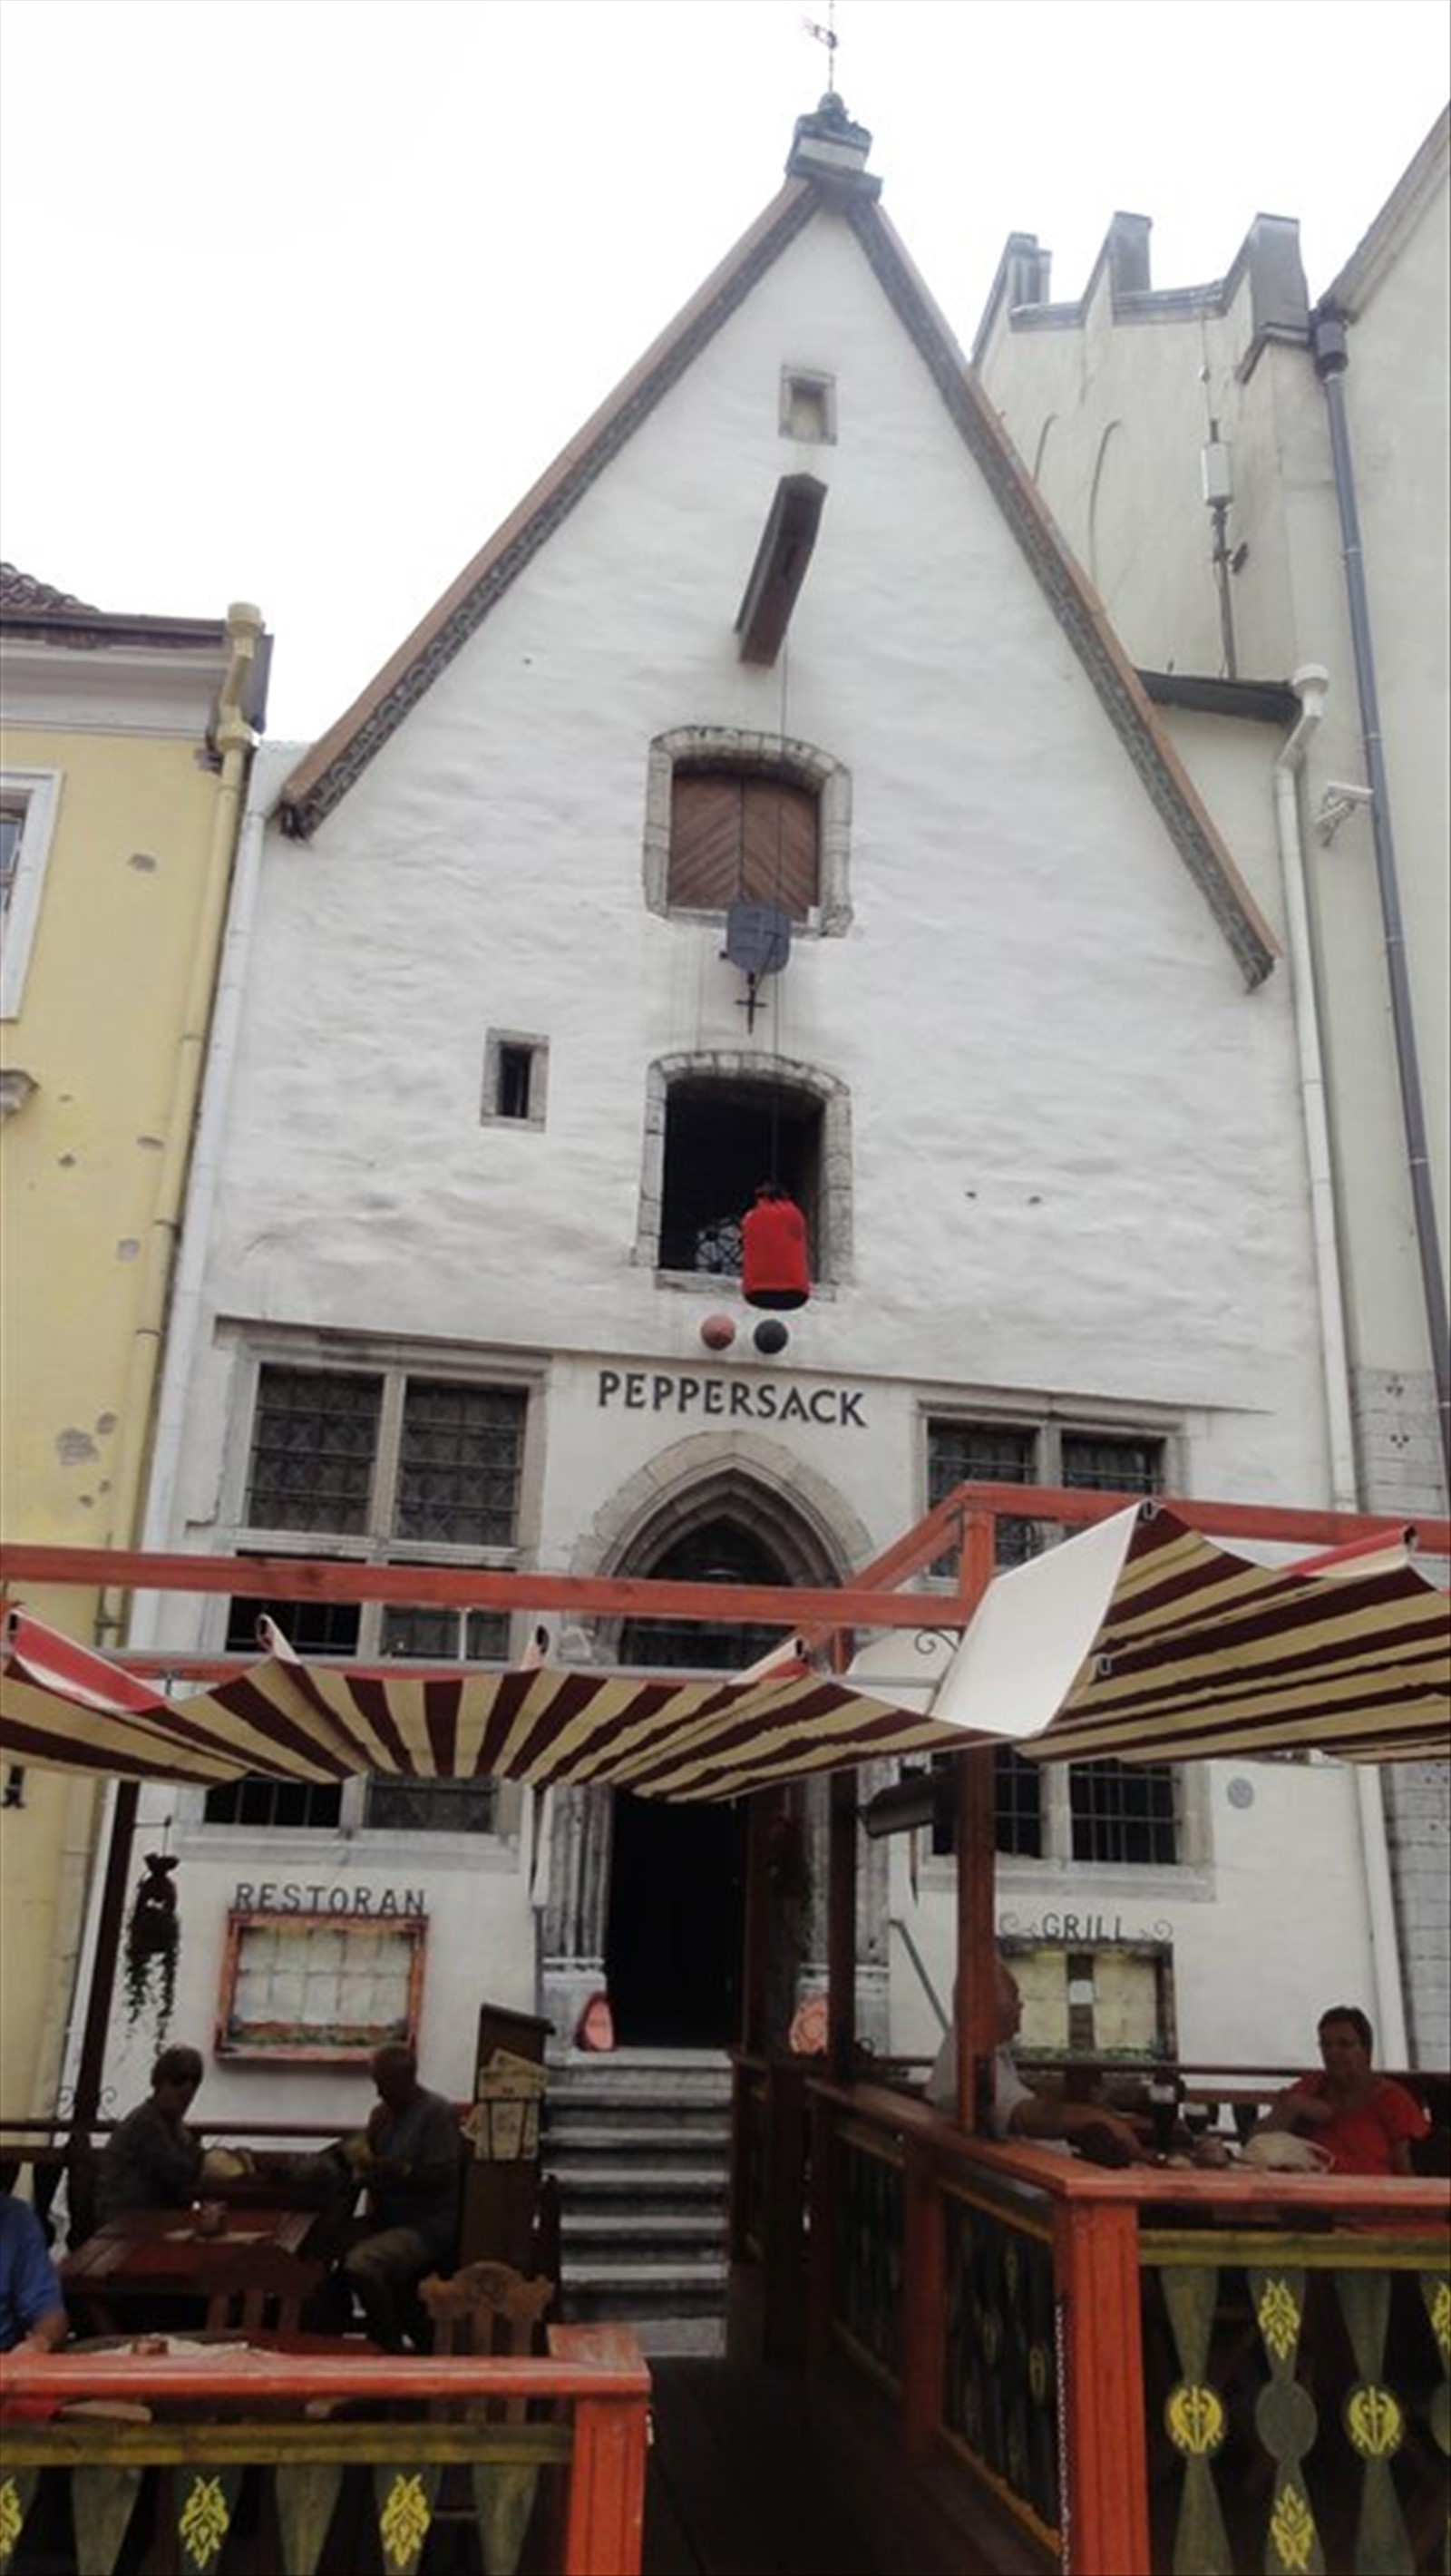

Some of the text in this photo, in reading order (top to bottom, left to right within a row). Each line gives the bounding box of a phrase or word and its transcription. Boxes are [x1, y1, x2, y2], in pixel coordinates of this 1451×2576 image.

[599, 1371, 866, 1428] PEPPERSACK
[233, 1883, 425, 1916] RESTORAN
[1044, 1913, 1125, 1940] GRILL
